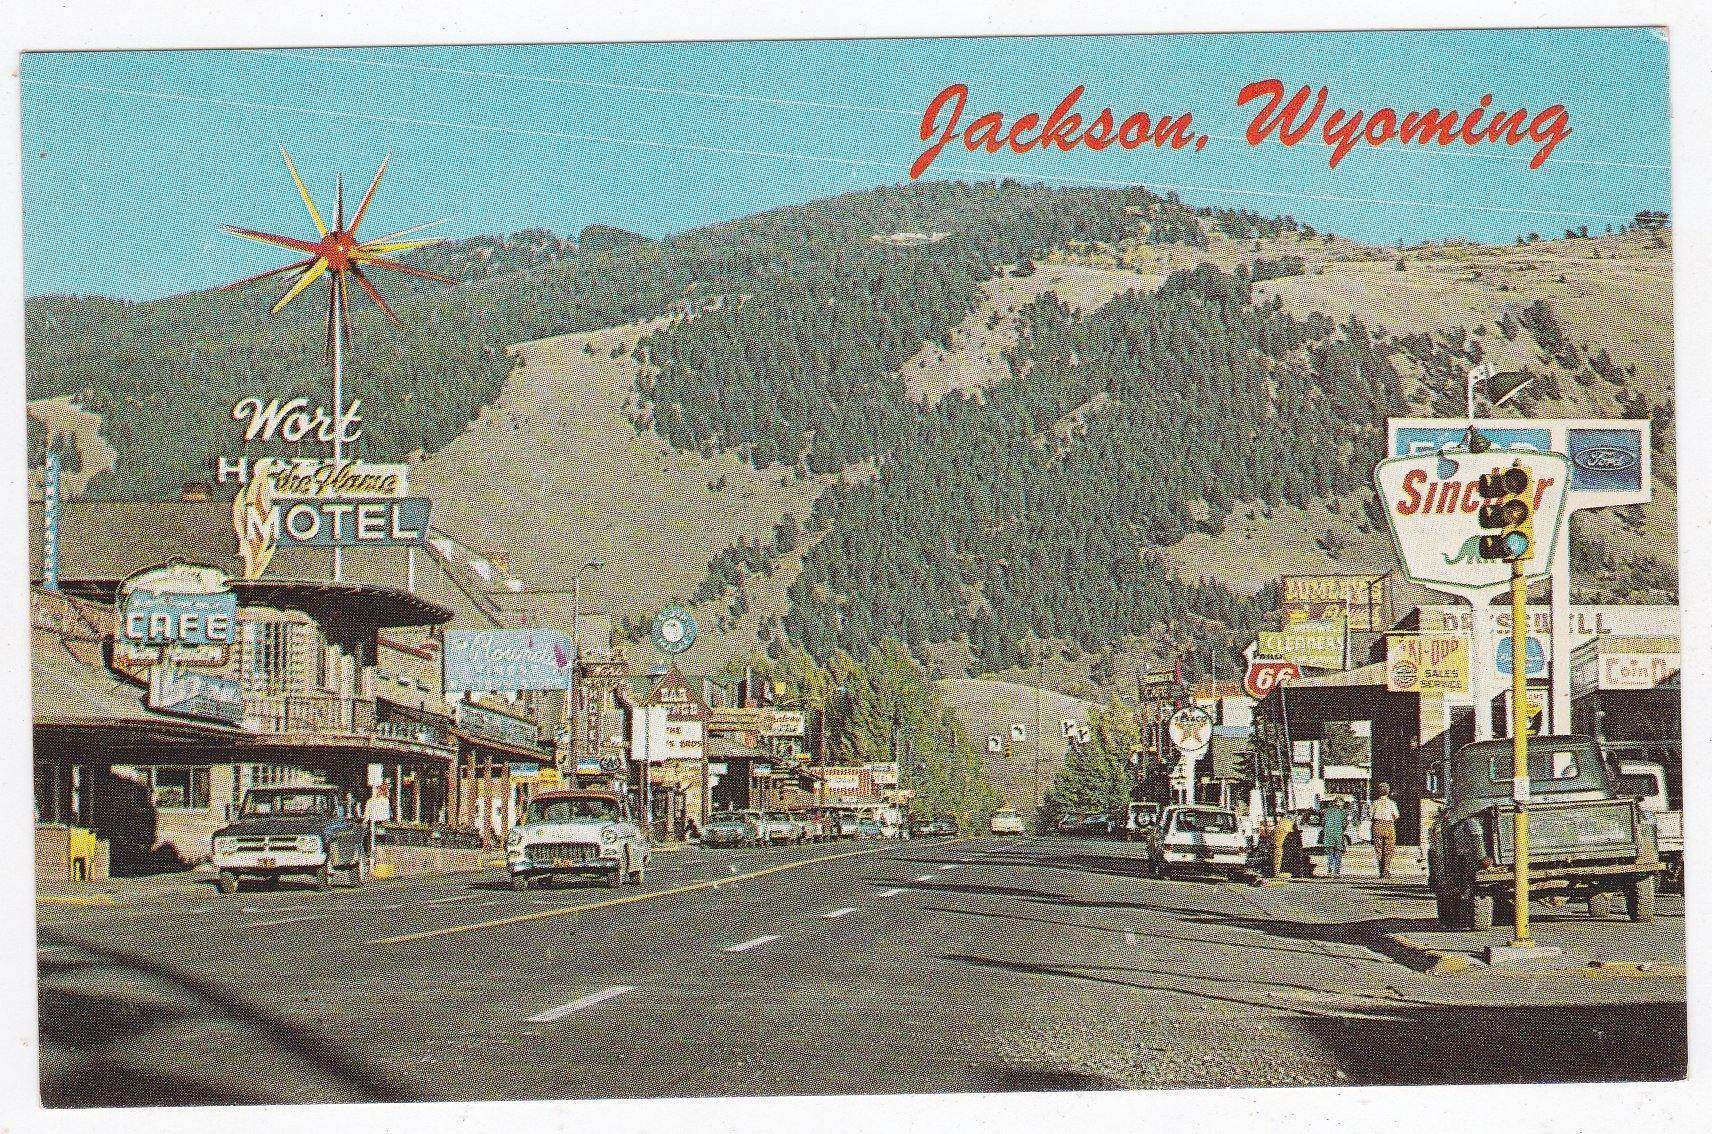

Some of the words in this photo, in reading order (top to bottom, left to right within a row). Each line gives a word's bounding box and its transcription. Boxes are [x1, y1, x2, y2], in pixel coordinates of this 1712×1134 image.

[232, 397, 362, 442] Wort
[1588, 450, 1624, 467] Ford
[269, 464, 311, 494] the
[314, 462, 398, 495] Flame
[1397, 467, 1554, 516] Sincr
[244, 503, 420, 541] MOTEL
[125, 613, 228, 640] CAFE
[1267, 635, 1344, 651] CLEANERS
[1256, 667, 1294, 690] 66
[1420, 679, 1463, 689] SERVICE
[1424, 669, 1459, 679] SALES
[1606, 657, 1649, 684] Coin
